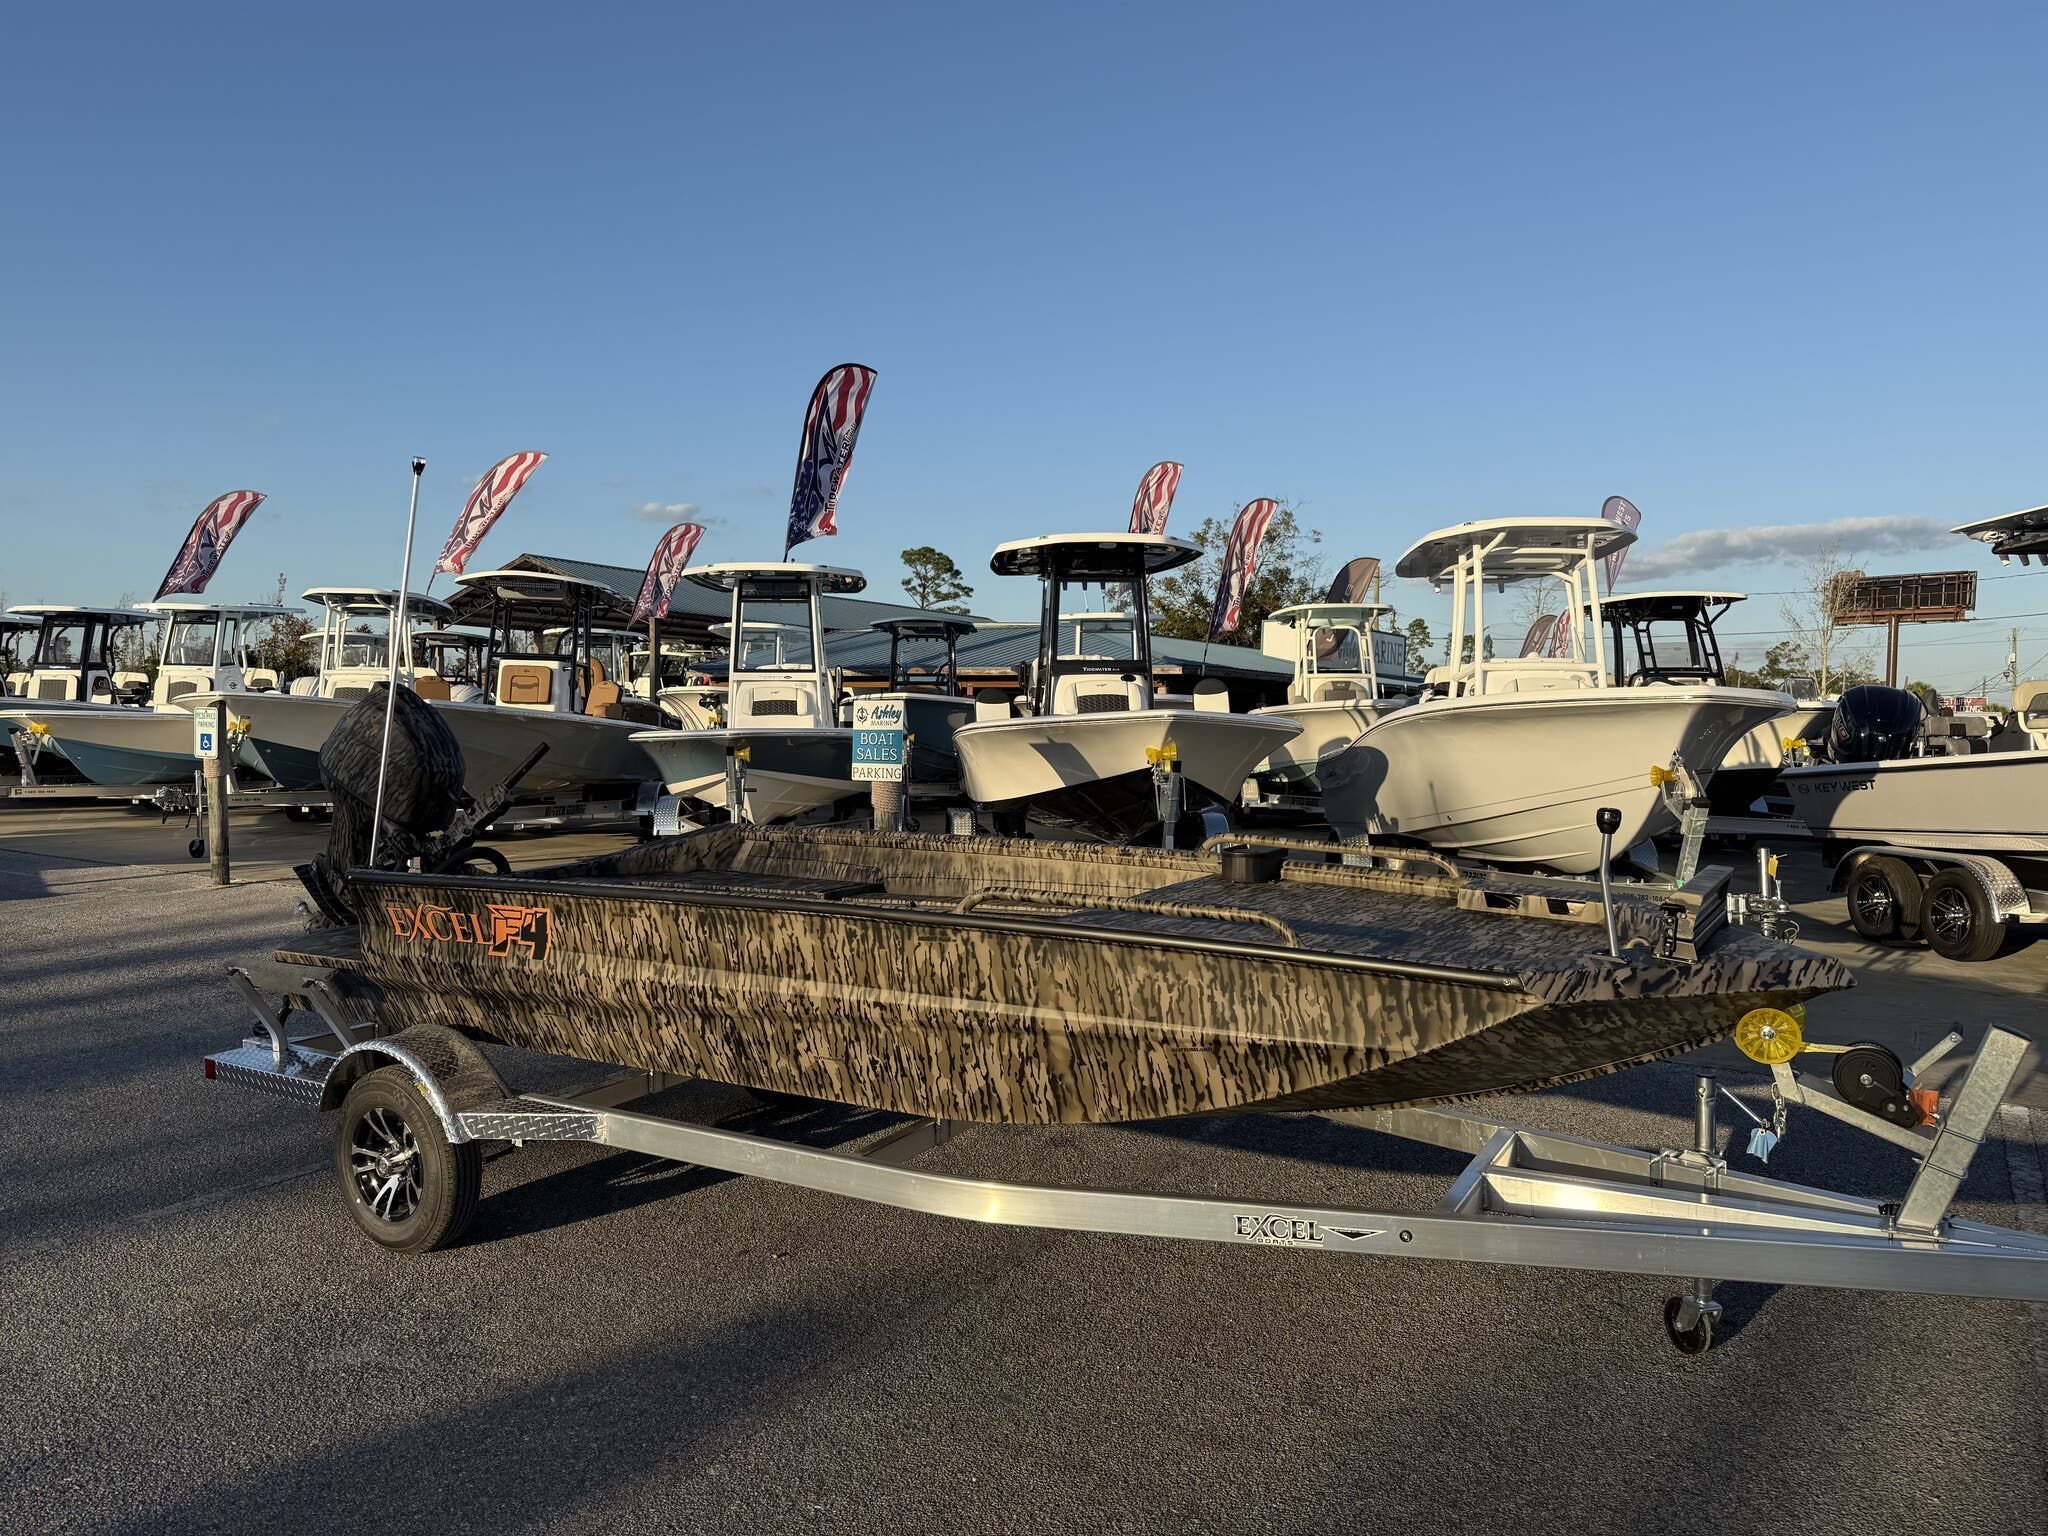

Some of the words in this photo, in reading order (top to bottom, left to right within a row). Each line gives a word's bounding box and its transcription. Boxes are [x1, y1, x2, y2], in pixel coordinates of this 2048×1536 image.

[824, 439, 851, 513] TIDEWATER
[1374, 640, 1403, 666] ARINE
[871, 704, 902, 724] Ashley
[860, 732, 895, 745] BOAT
[856, 747, 898, 761] SALES
[852, 767, 902, 779] PARKING
[1815, 783, 1837, 793] KEY
[1841, 780, 1875, 791] WEST
[386, 904, 494, 945] EXCEL
[486, 904, 551, 960] F4
[1234, 1213, 1325, 1242] EXCEL
[1257, 1237, 1295, 1246] BOATS
